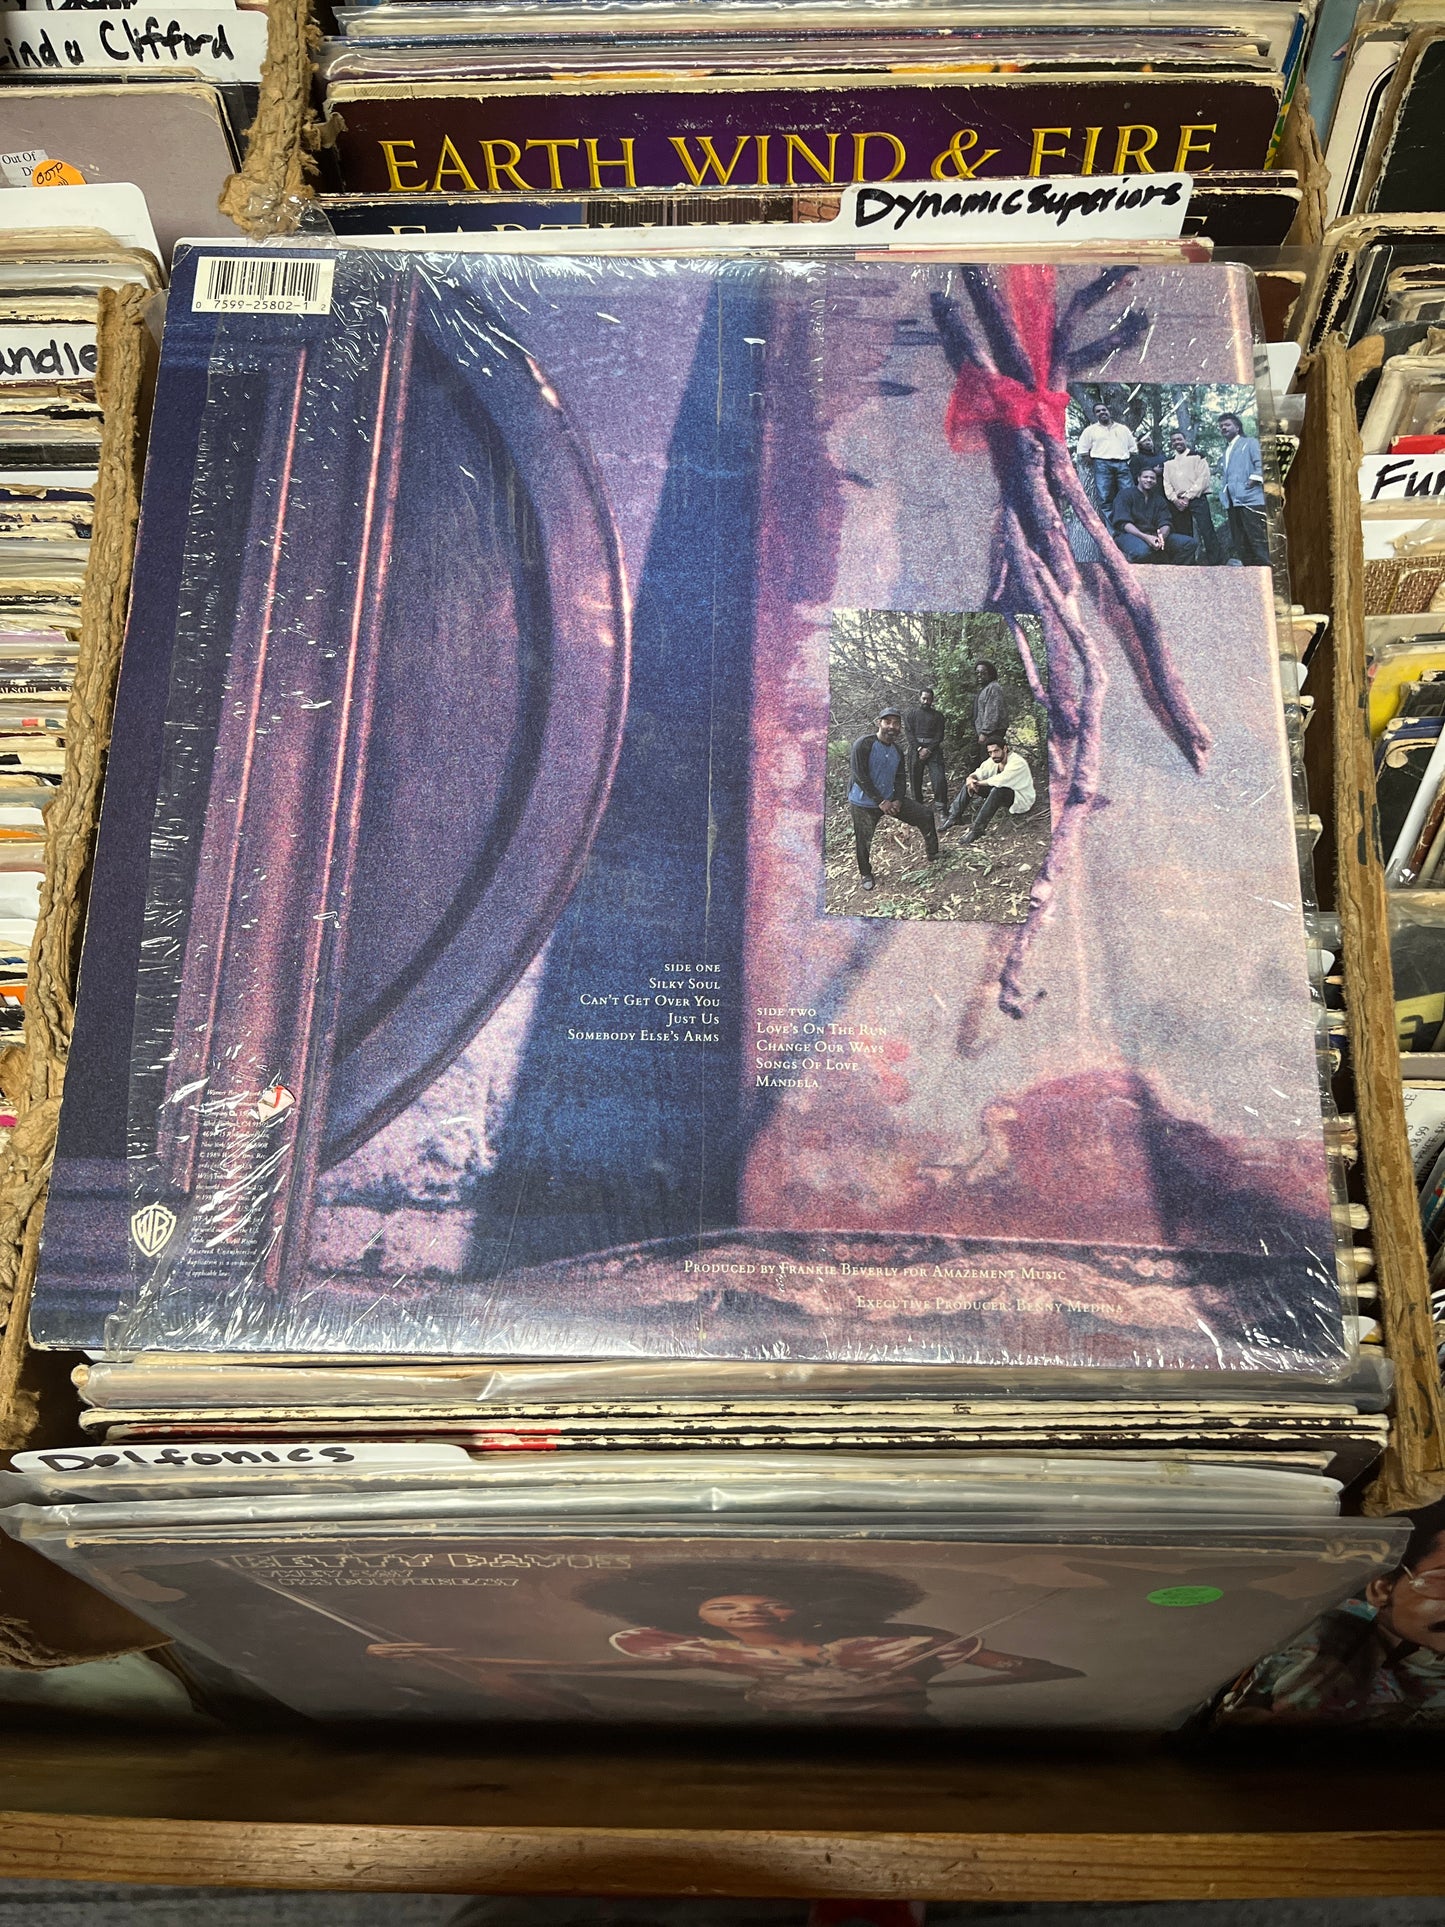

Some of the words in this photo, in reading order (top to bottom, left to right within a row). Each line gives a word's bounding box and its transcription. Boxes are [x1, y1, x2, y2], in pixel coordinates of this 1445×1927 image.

[99, 16, 235, 62] Clifford
[2, 154, 21, 165] Out
[22, 151, 37, 162] Of
[377, 134, 639, 192] EARTH
[667, 131, 907, 186] WIND
[929, 128, 1001, 181] &
[1029, 123, 1218, 178] FIRE
[855, 188, 1023, 230] Dynamic
[214, 300, 309, 310] 7599-25802-1
[664, 963, 692, 972] SIDE
[695, 963, 721, 973] ONE
[756, 1007, 785, 1016] SIDE
[789, 1008, 817, 1017] TWO
[134, 1206, 174, 1252] WB
